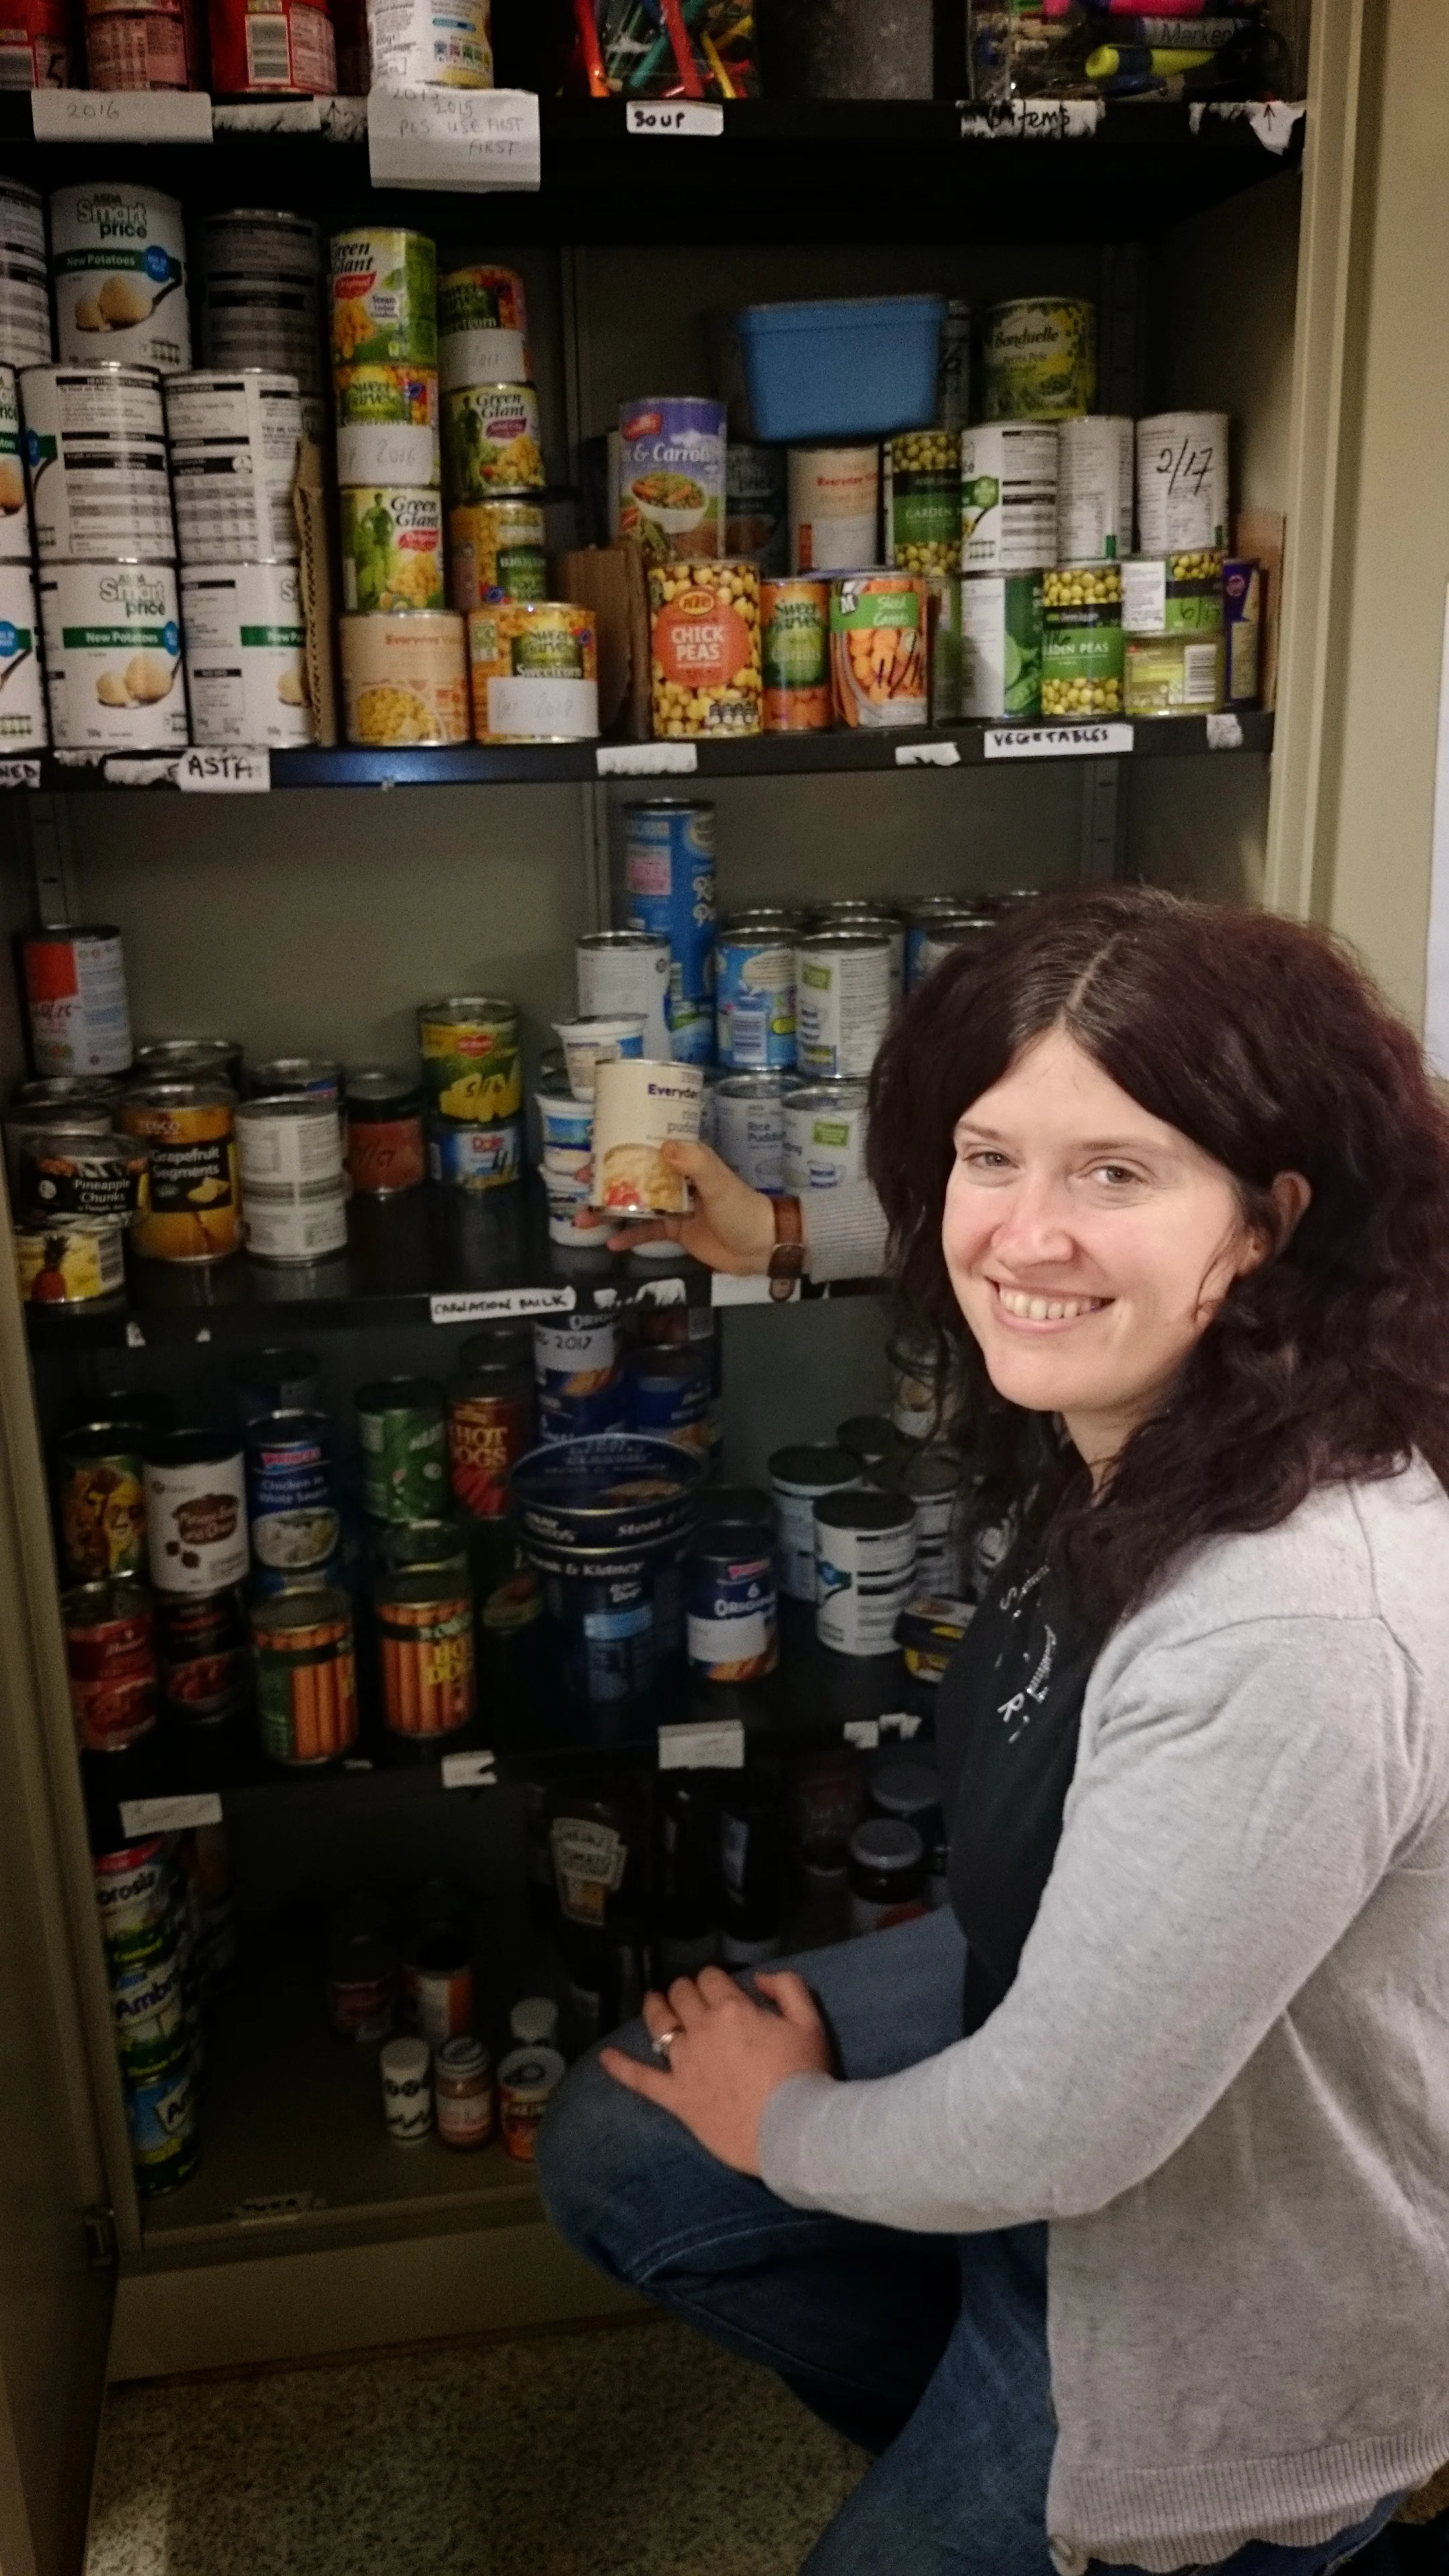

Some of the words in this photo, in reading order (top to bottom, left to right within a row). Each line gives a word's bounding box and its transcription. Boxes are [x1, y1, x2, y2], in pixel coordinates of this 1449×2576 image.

[66, 99, 120, 120] 2016
[76, 199, 148, 226] Smart
[99, 221, 147, 239] price
[333, 240, 371, 259] reen
[87, 253, 135, 267] Potatoes
[333, 256, 374, 274] iant
[995, 325, 1059, 348] Bonduelle
[476, 392, 521, 406] Green
[481, 404, 525, 419] Giant
[1155, 437, 1214, 496] 2/17
[390, 496, 439, 513] Green
[394, 511, 439, 528] Giant
[100, 578, 166, 603] Smart
[125, 600, 166, 619] price
[85, 631, 112, 643] New
[671, 625, 725, 644] CHICK
[676, 643, 721, 661] PEAS
[1079, 641, 1109, 655] PEAS
[994, 728, 1109, 747] VEGETABLES
[647, 1083, 698, 1099] Everyda
[151, 1146, 221, 1167] Grapefruit
[152, 1164, 221, 1181] Segments
[72, 1178, 131, 1193] Pineapple
[79, 1192, 126, 1203] Chunks
[455, 1425, 508, 1448] HOT
[260, 1477, 311, 1491] Chicken
[582, 1560, 645, 1576] Kidney
